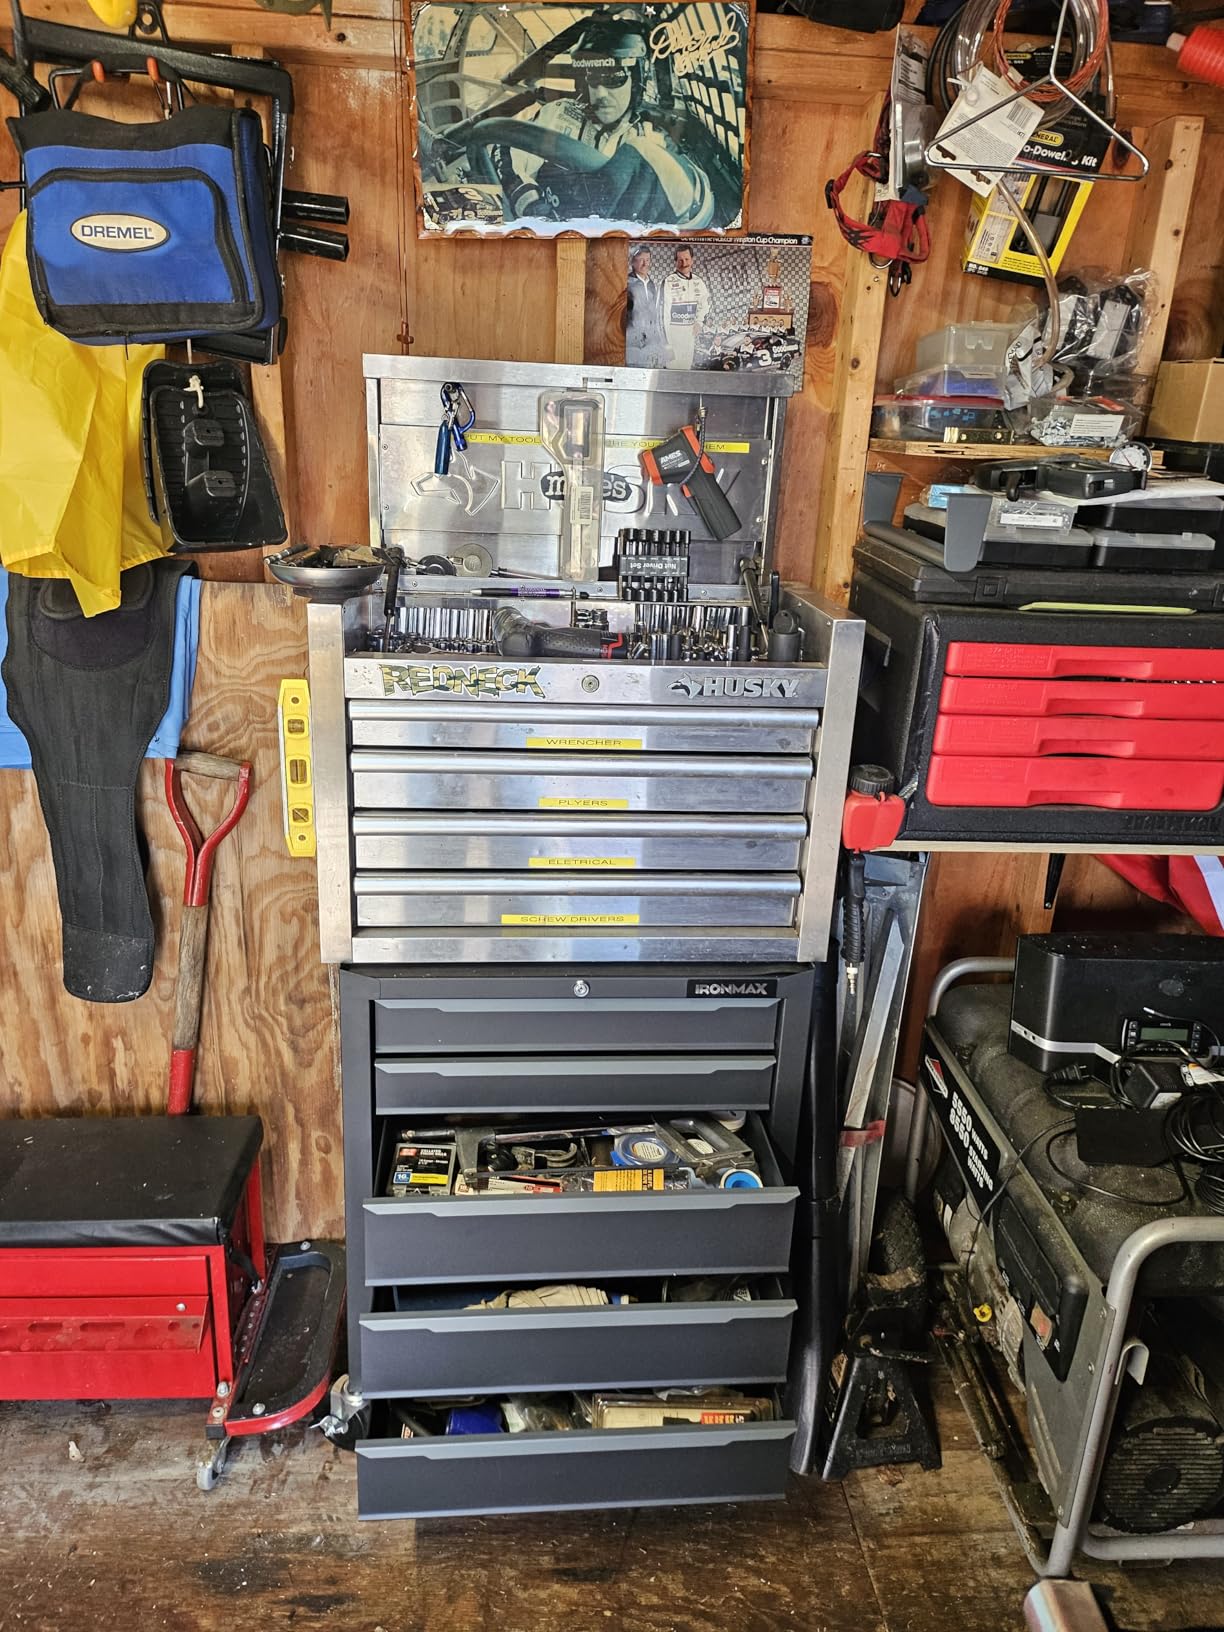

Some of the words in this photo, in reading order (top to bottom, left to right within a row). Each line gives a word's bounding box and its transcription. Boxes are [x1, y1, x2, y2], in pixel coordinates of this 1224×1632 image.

[1081, 155, 1098, 167] Kit
[81, 224, 155, 240] DREMEL
[756, 236, 767, 244] Cup
[759, 350, 772, 366] 3
[660, 450, 682, 464] AMES
[545, 474, 627, 499] me's
[379, 663, 547, 699] REDNECK
[703, 677, 800, 698] HUSKY
[558, 799, 608, 807] PLYERS
[695, 983, 768, 995] IRONMAX
[952, 1091, 972, 1132] 5550
[971, 1128, 988, 1160] WATTS
[949, 1107, 970, 1148] 8550
[968, 1145, 994, 1191] STARTING
